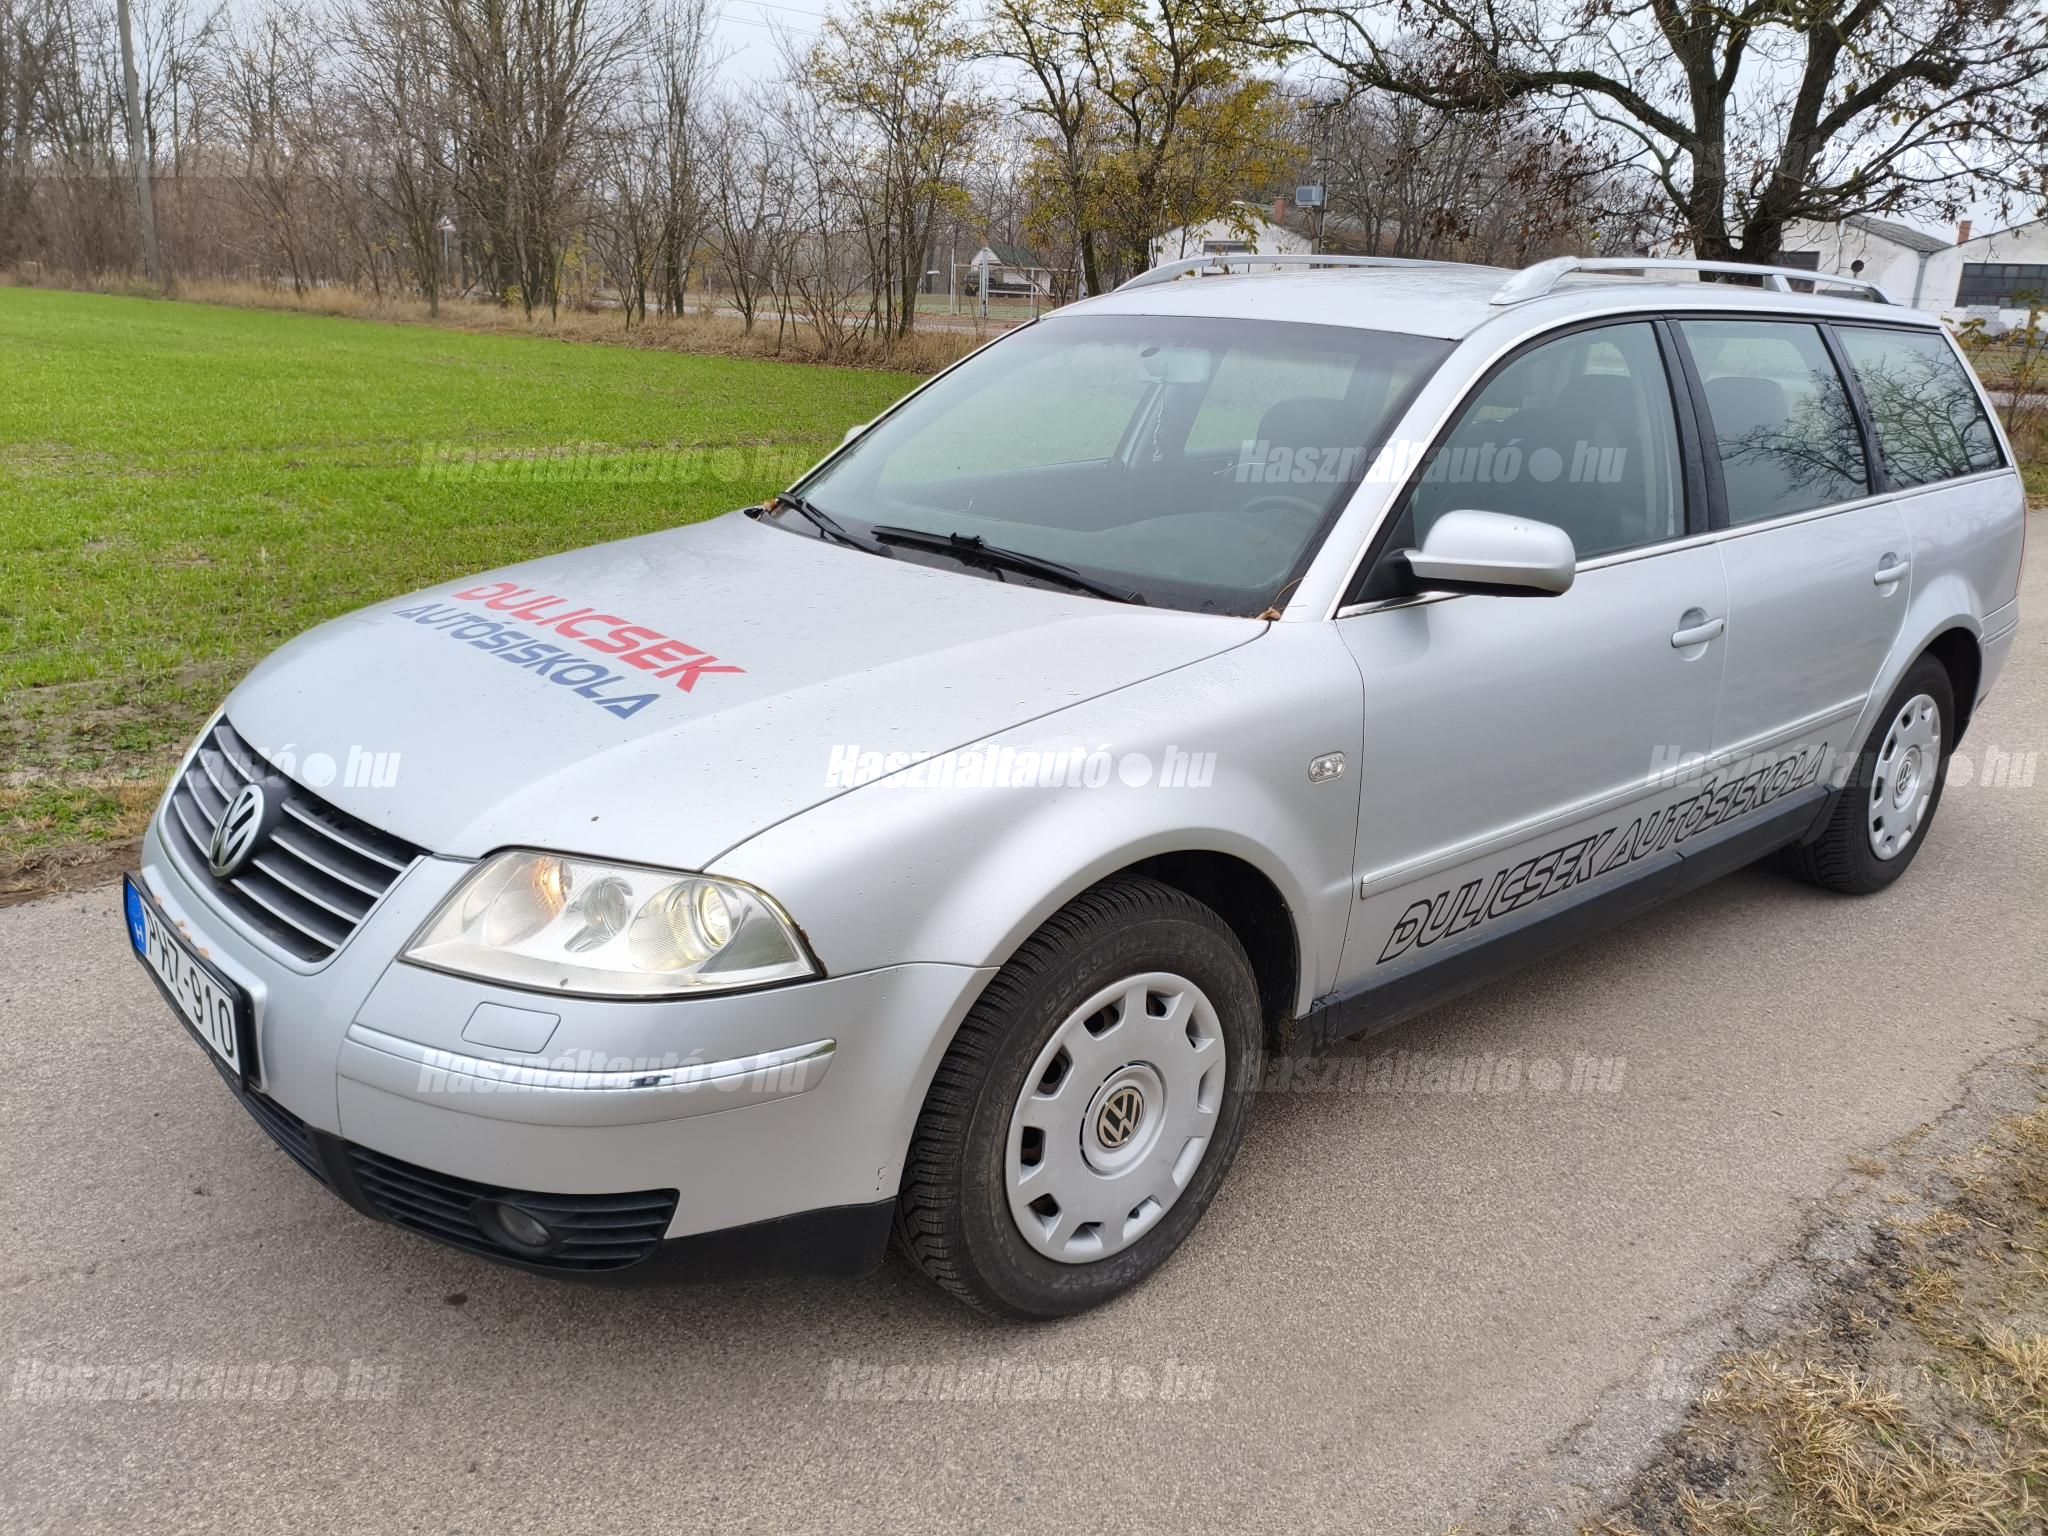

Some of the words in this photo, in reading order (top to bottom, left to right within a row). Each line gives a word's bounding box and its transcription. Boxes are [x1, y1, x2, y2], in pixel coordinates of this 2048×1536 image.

[391, 603, 661, 720] AUTÓSISKOLA
[452, 582, 748, 693] DULICSEK
[1375, 826, 1617, 966] DULICSEK
